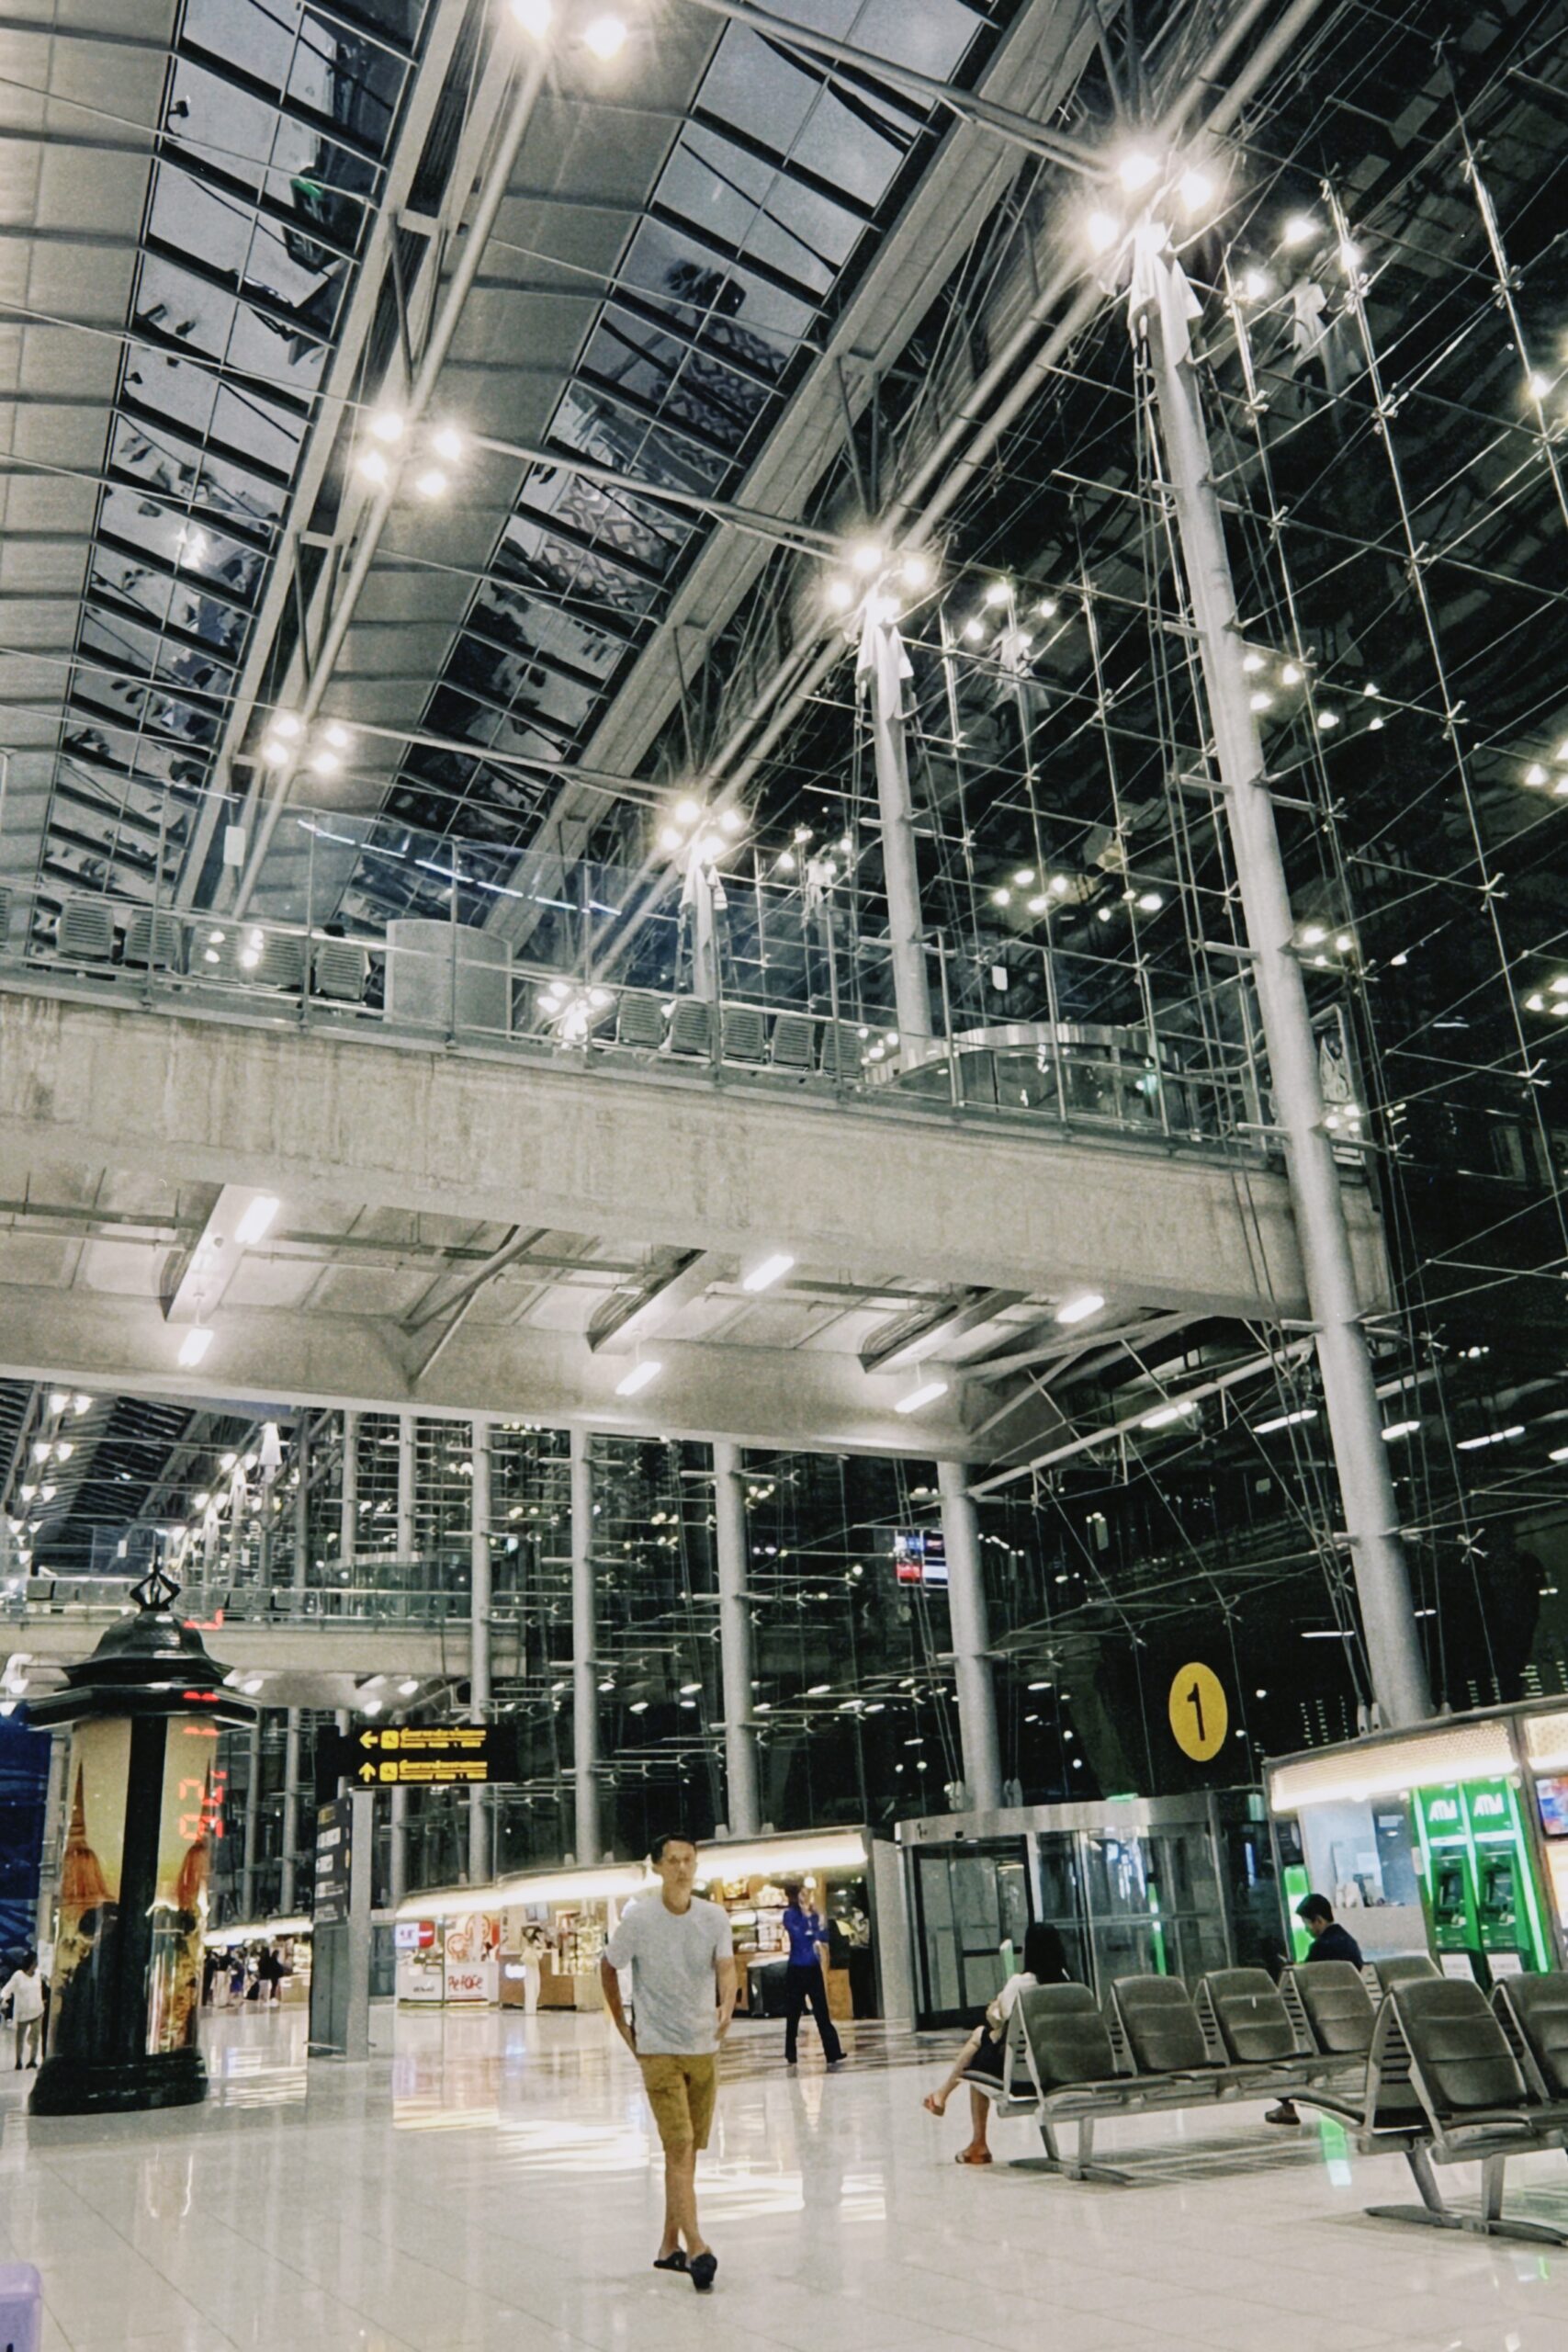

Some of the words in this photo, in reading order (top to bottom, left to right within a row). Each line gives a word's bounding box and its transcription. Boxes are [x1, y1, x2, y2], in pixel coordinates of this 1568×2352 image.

[1187, 1681, 1206, 1741] 1
[1428, 1799, 1459, 1822] ATM
[1472, 1793, 1505, 1817] ATM
